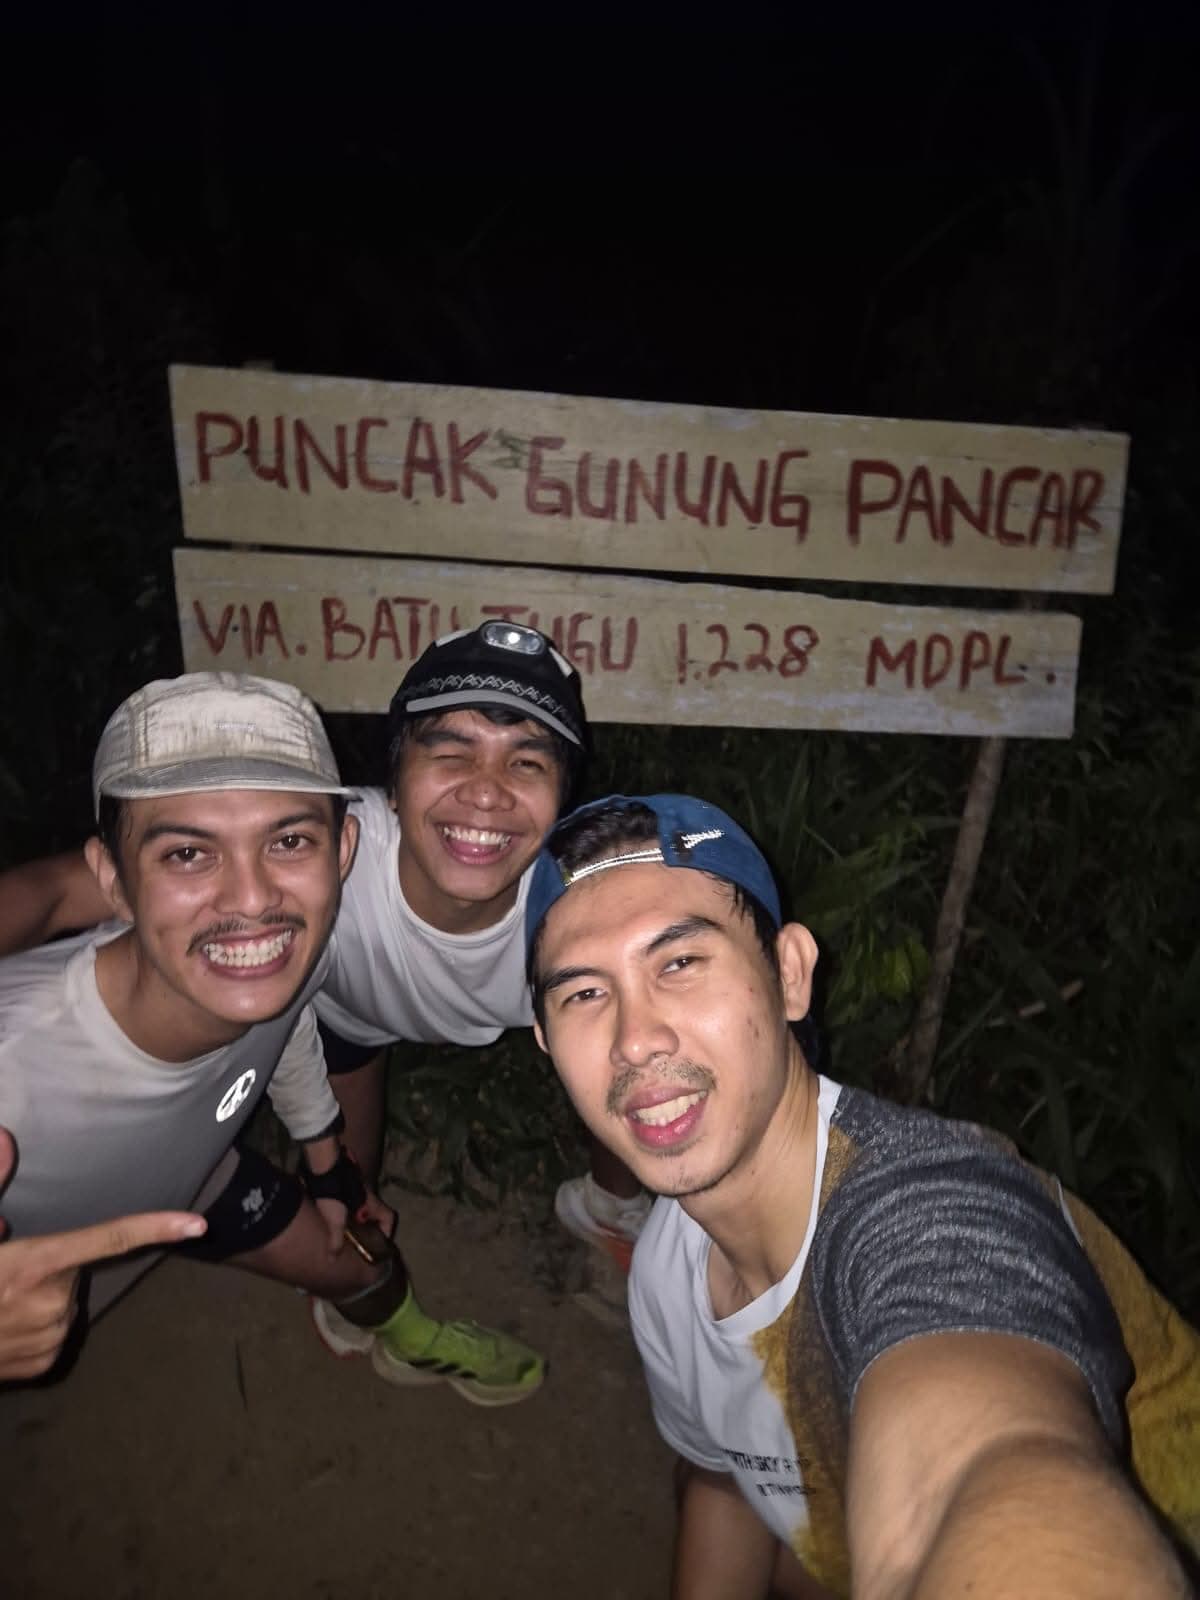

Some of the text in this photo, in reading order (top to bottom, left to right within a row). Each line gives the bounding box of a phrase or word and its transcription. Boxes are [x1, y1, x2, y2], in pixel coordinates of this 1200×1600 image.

[195, 411, 1105, 549] PUNCAK GUNUNG PANCAR
[193, 600, 307, 661] VIA.
[677, 623, 819, 685] 1.228
